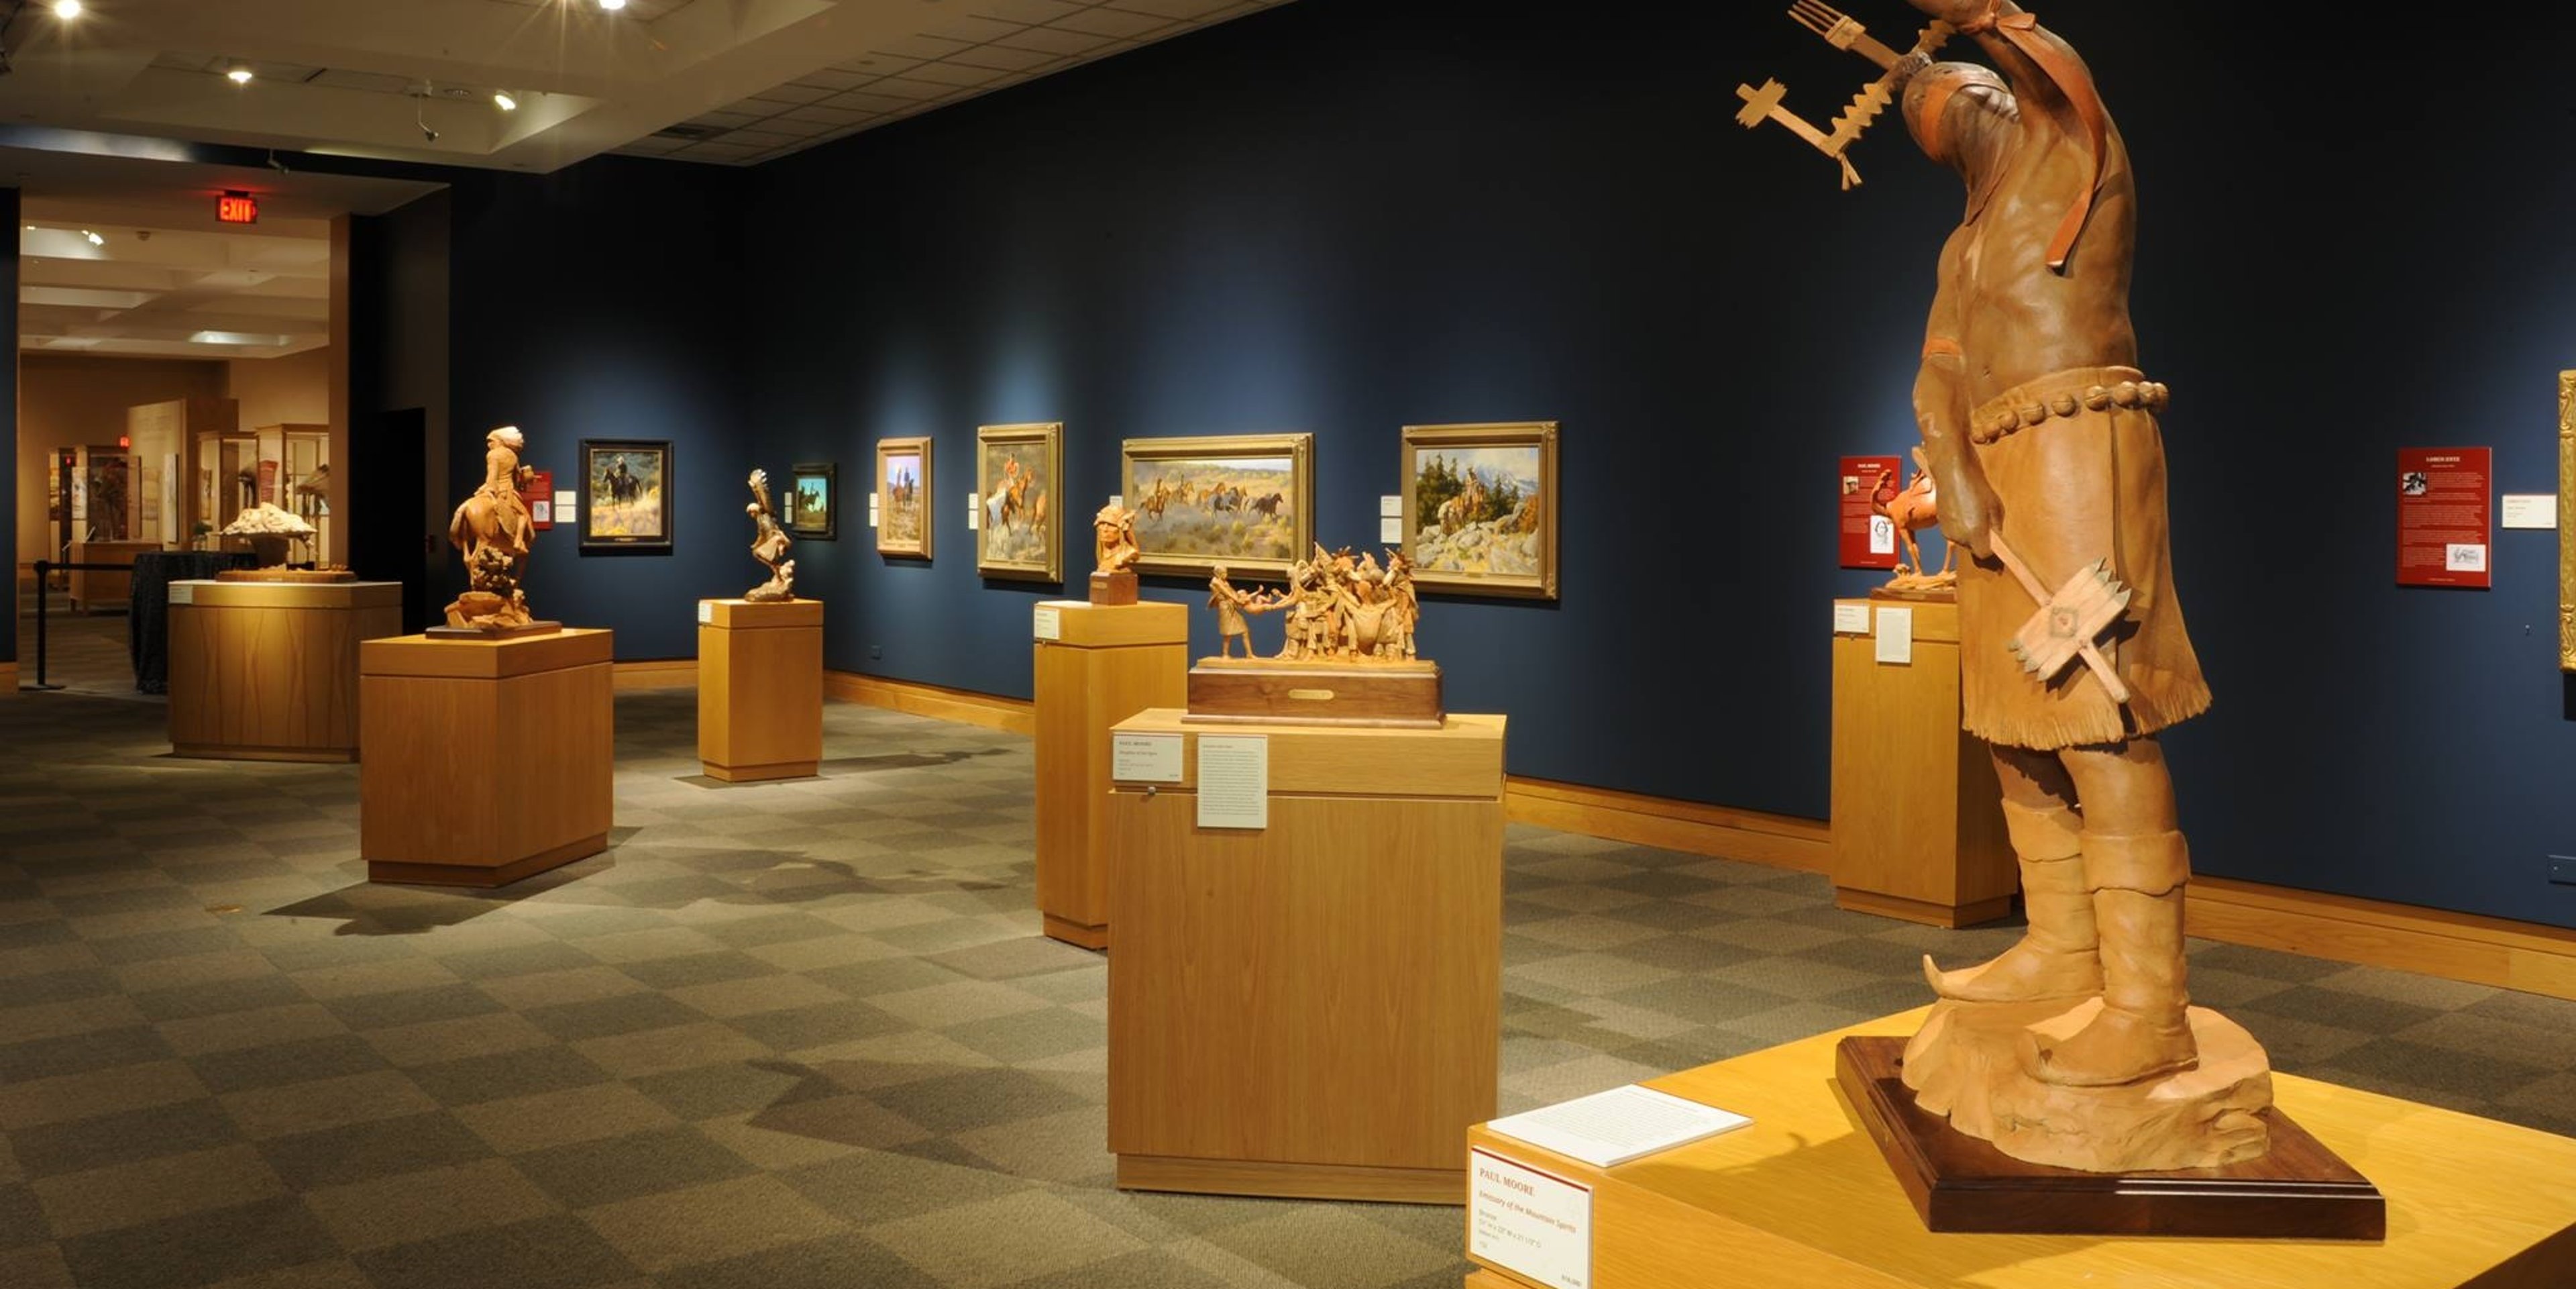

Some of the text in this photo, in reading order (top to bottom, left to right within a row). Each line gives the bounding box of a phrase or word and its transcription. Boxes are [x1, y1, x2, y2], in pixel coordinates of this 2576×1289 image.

[220, 197, 252, 222] EXIT
[1479, 1168, 1535, 1196] PAUL MOORE
